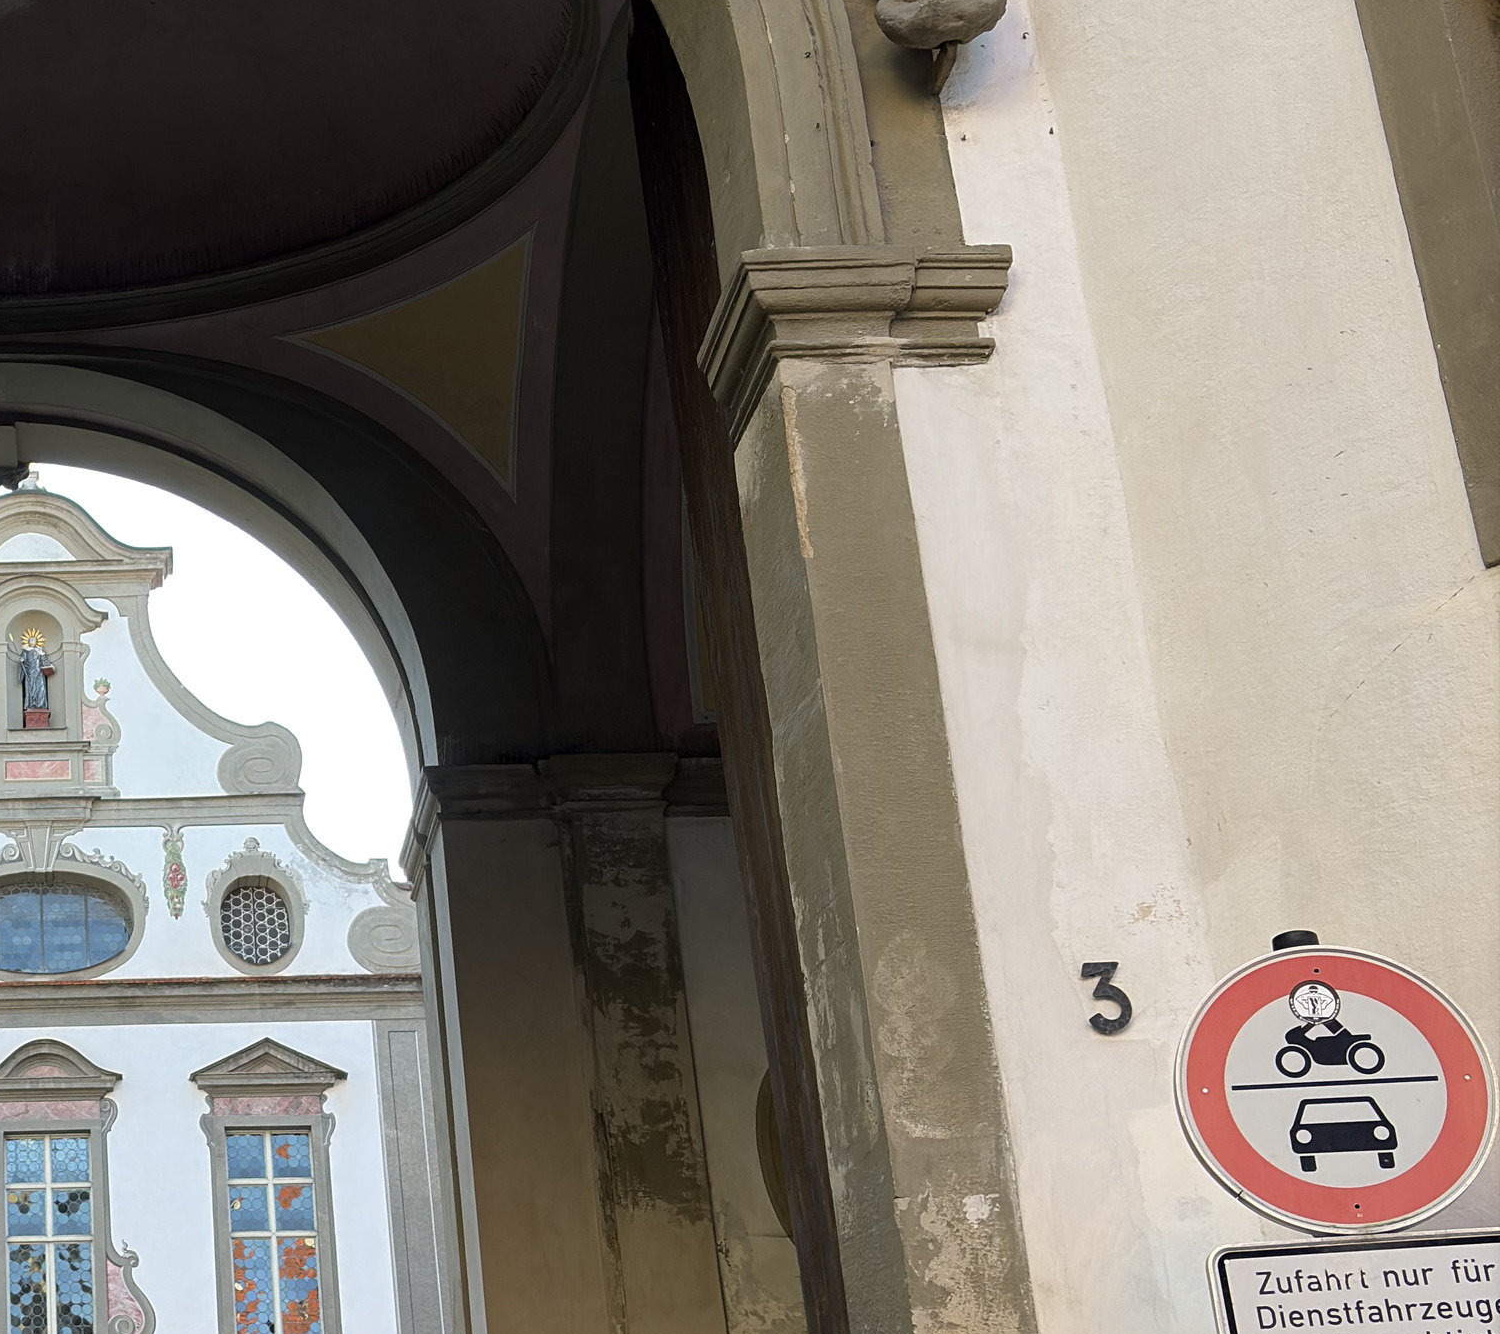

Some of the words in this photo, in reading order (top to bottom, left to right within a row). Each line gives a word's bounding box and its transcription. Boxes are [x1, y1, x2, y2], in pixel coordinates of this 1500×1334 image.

[1081, 961, 1132, 1034] 3
[1256, 1268, 1369, 1295] Zufahrt
[1383, 1267, 1433, 1287] nur
[1451, 1259, 1495, 1283] für
